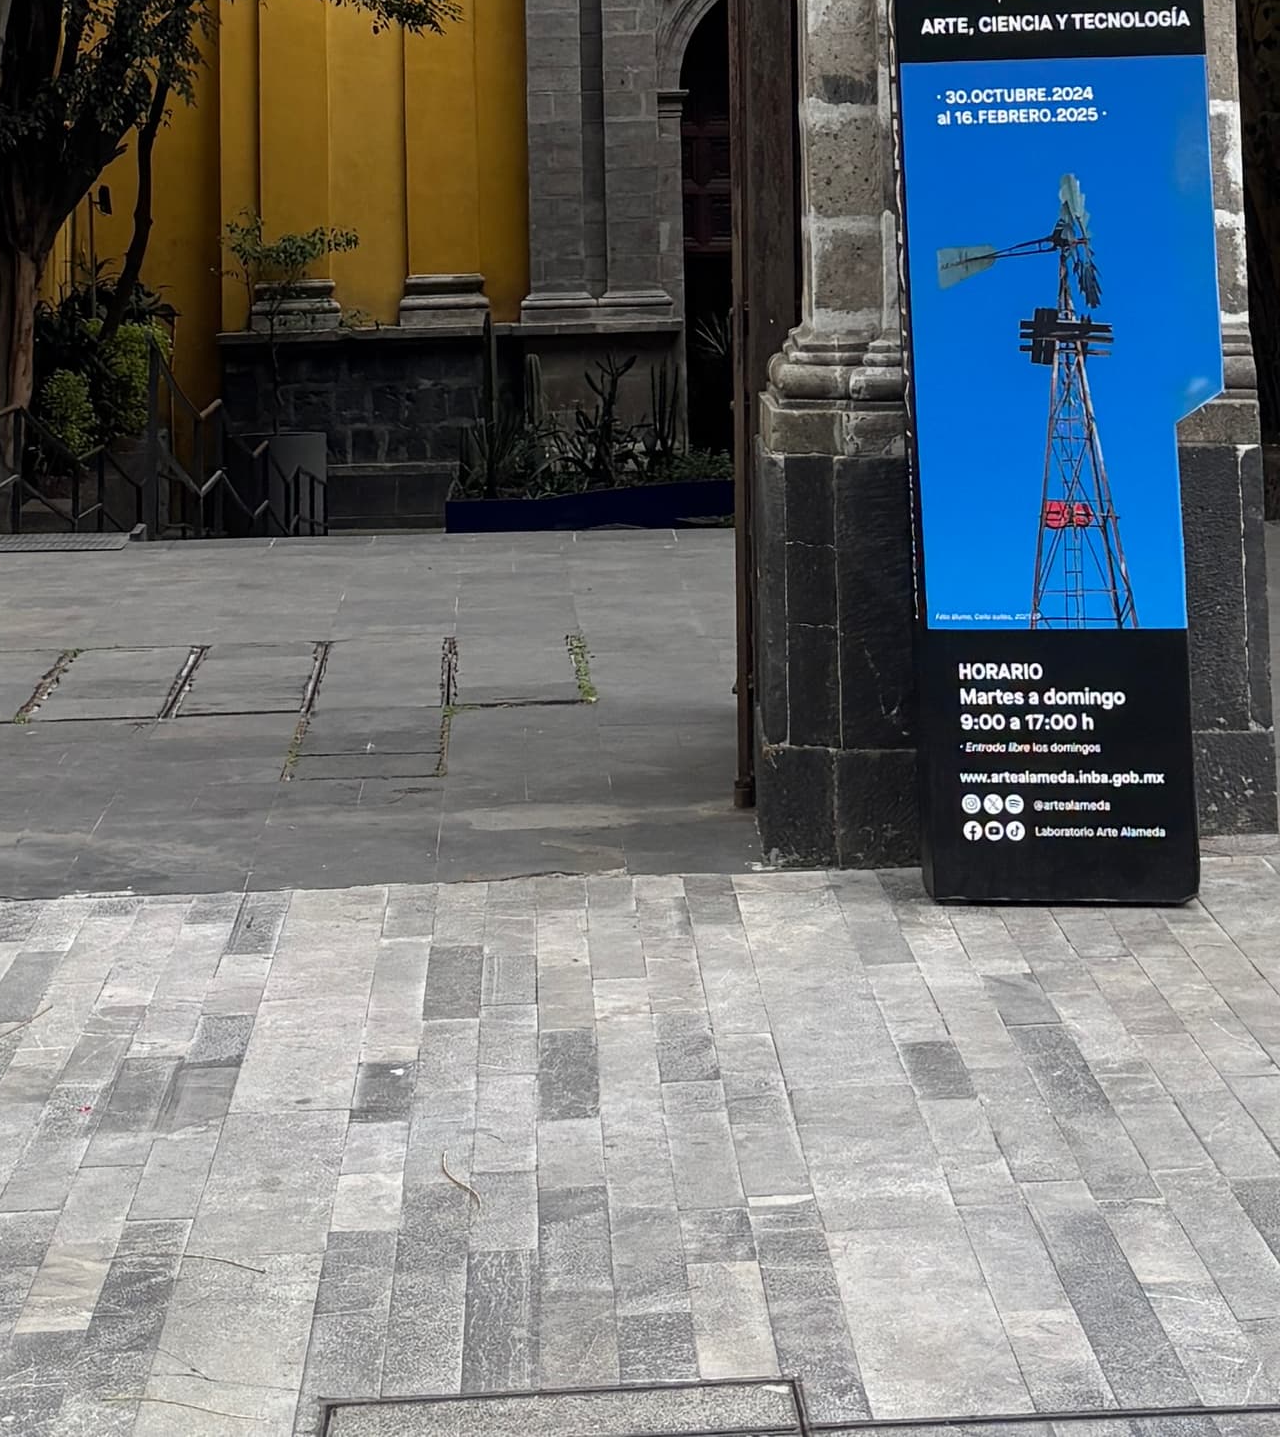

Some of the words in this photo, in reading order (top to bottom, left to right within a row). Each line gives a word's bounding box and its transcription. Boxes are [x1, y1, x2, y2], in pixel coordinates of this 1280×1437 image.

[921, 17, 973, 36] ARTE,
[978, 14, 1053, 33] CIENCIA
[1055, 14, 1069, 29] Y
[1071, 7, 1191, 29] TECNOLOGÍA
[945, 86, 1094, 104] 30.OCTUBRE.2024
[937, 111, 951, 125] al
[955, 107, 1098, 124] 16.FEBRERO.2025
[958, 663, 1043, 680] HORARIO
[959, 688, 1024, 705] Martes
[1028, 692, 1039, 705] a
[1043, 687, 1126, 710] domingo
[960, 713, 1006, 730] 9:00
[1009, 716, 1020, 730] a
[1025, 713, 1077, 730] 17:00
[1081, 712, 1095, 730] h
[965, 742, 1006, 753] Entrada
[1008, 742, 1031, 753] libre
[1032, 742, 1049, 753] los
[1050, 742, 1101, 756] domingos
[959, 770, 1166, 787] www.artealameda.inba.gob.mx
[1033, 799, 1111, 812] @artealameda
[1035, 826, 1095, 838] Laboratorio
[1096, 826, 1119, 838] Arte
[1120, 826, 1166, 838] Alameda
